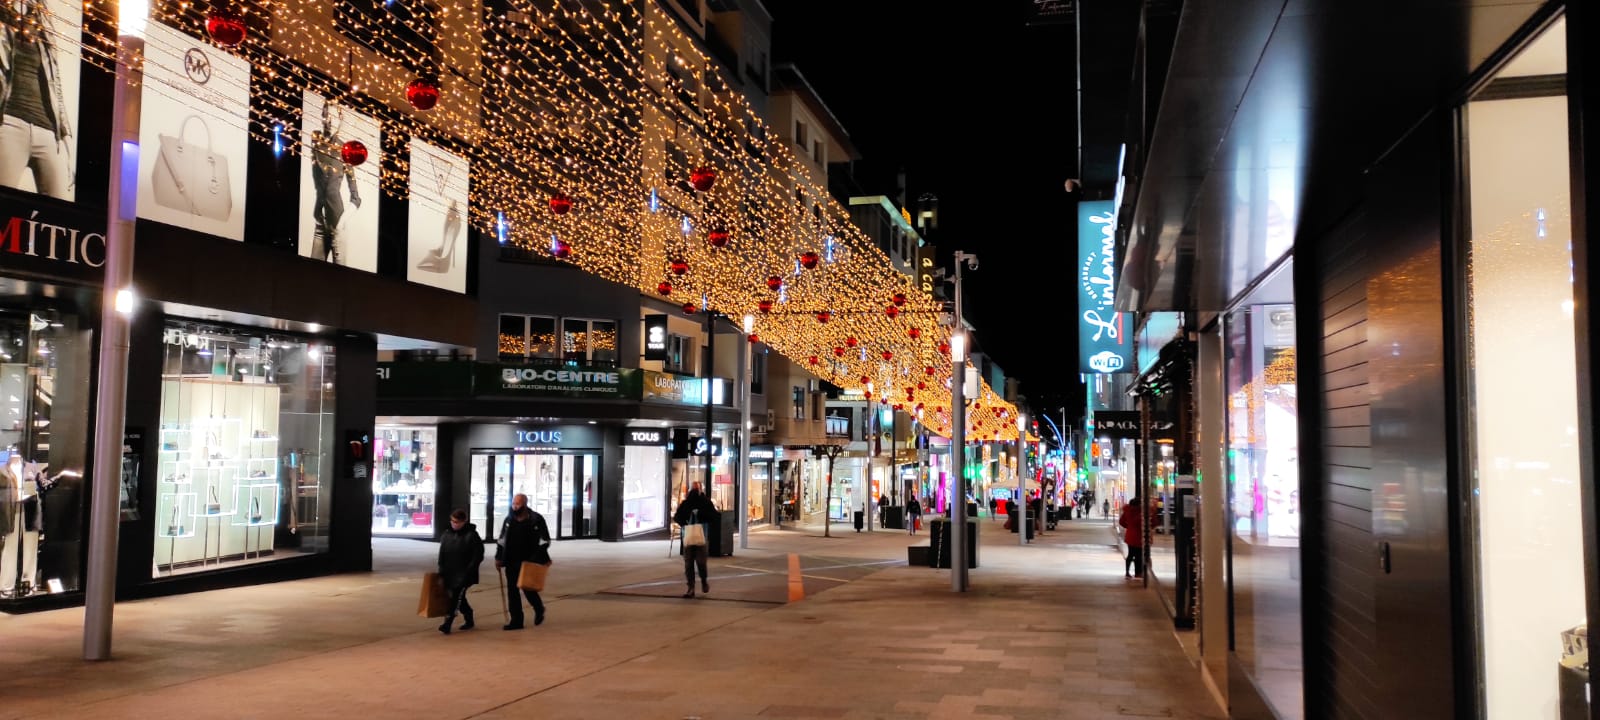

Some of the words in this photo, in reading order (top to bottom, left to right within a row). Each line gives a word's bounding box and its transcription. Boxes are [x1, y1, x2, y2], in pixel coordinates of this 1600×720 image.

[1082, 252, 1097, 299] RESTAURANT
[502, 368, 619, 384] BIO-CENTRE
[516, 430, 562, 443] TOUS
[631, 432, 659, 442] TOUS
